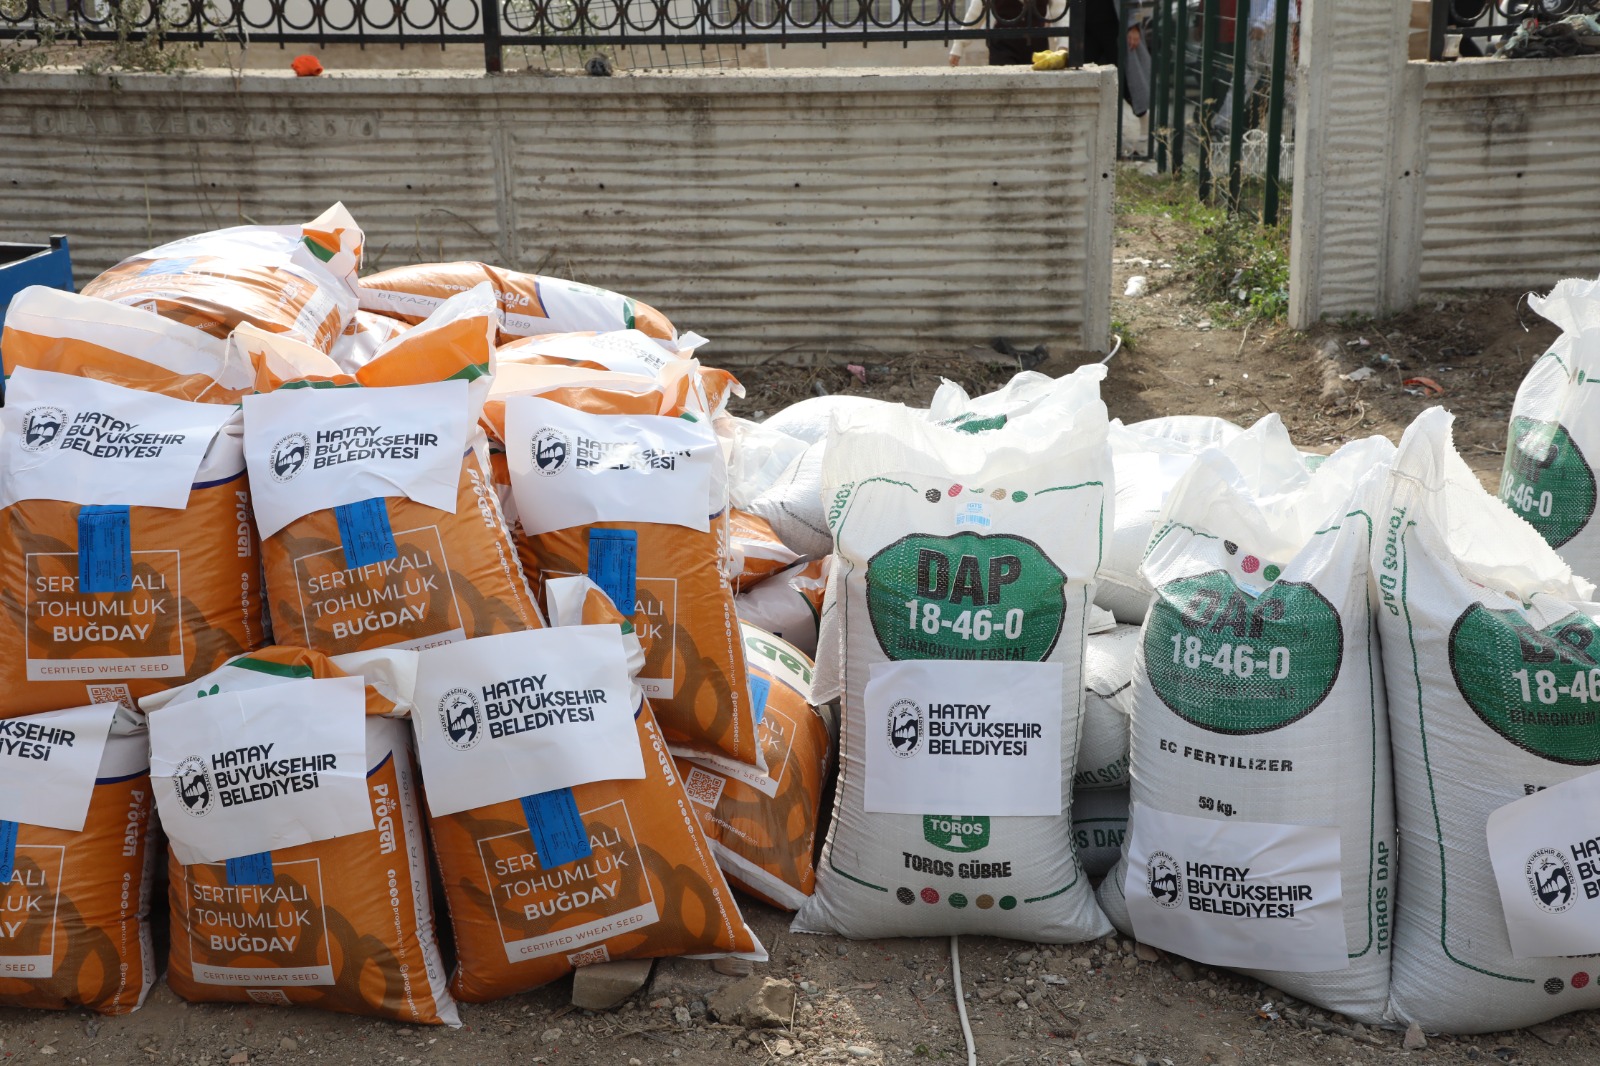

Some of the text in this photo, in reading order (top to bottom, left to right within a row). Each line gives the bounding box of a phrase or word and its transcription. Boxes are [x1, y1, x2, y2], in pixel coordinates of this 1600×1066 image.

[74, 412, 140, 432] HATAY
[316, 425, 382, 444] HATAY
[915, 548, 1023, 606] DAP
[37, 598, 167, 617] TOHUMLUK
[312, 574, 439, 618] TOHUMLUK
[53, 621, 150, 642] BUĞDAY
[332, 602, 427, 640] BUĞDAY
[904, 599, 1024, 641] 18-46-0
[40, 663, 169, 675] CERTIFIED WHEAT SEED
[1171, 633, 1291, 680] 18-46-0
[482, 674, 547, 702] HATAY
[485, 688, 607, 721] BÜYÜKŞEHİR
[928, 703, 991, 720] HATAY
[489, 706, 595, 739] BELEDİYESİ
[928, 721, 1042, 739] BÜYÜKŞEHİR
[212, 743, 275, 770] HATAY
[928, 739, 1028, 756] BELEDİYESİ
[1159, 738, 1293, 772] EC FERTILIZER
[214, 753, 337, 789] BÜYÜKŞEHİR
[219, 772, 319, 808] BELEDİYESİ
[929, 818, 983, 836] TOROS
[501, 852, 629, 901] TOHUMLUK
[903, 852, 1012, 879] TOROS GÜBRE
[1186, 861, 1250, 882] HATAY
[523, 879, 619, 922] BUĞDAY
[1187, 878, 1313, 903] BÜYÜKŞEHİR
[1377, 841, 1390, 955] TOROS DAP
[195, 909, 311, 929] TOHUMLUK
[1188, 896, 1295, 918] BELEDİYESİ
[210, 931, 297, 953] BUĞDAY
[519, 914, 643, 954] CERTIFIED WHEAT SEED
[5, 963, 36, 972] SEED
[203, 970, 319, 982] CERTIFIED WHEAT SEED
